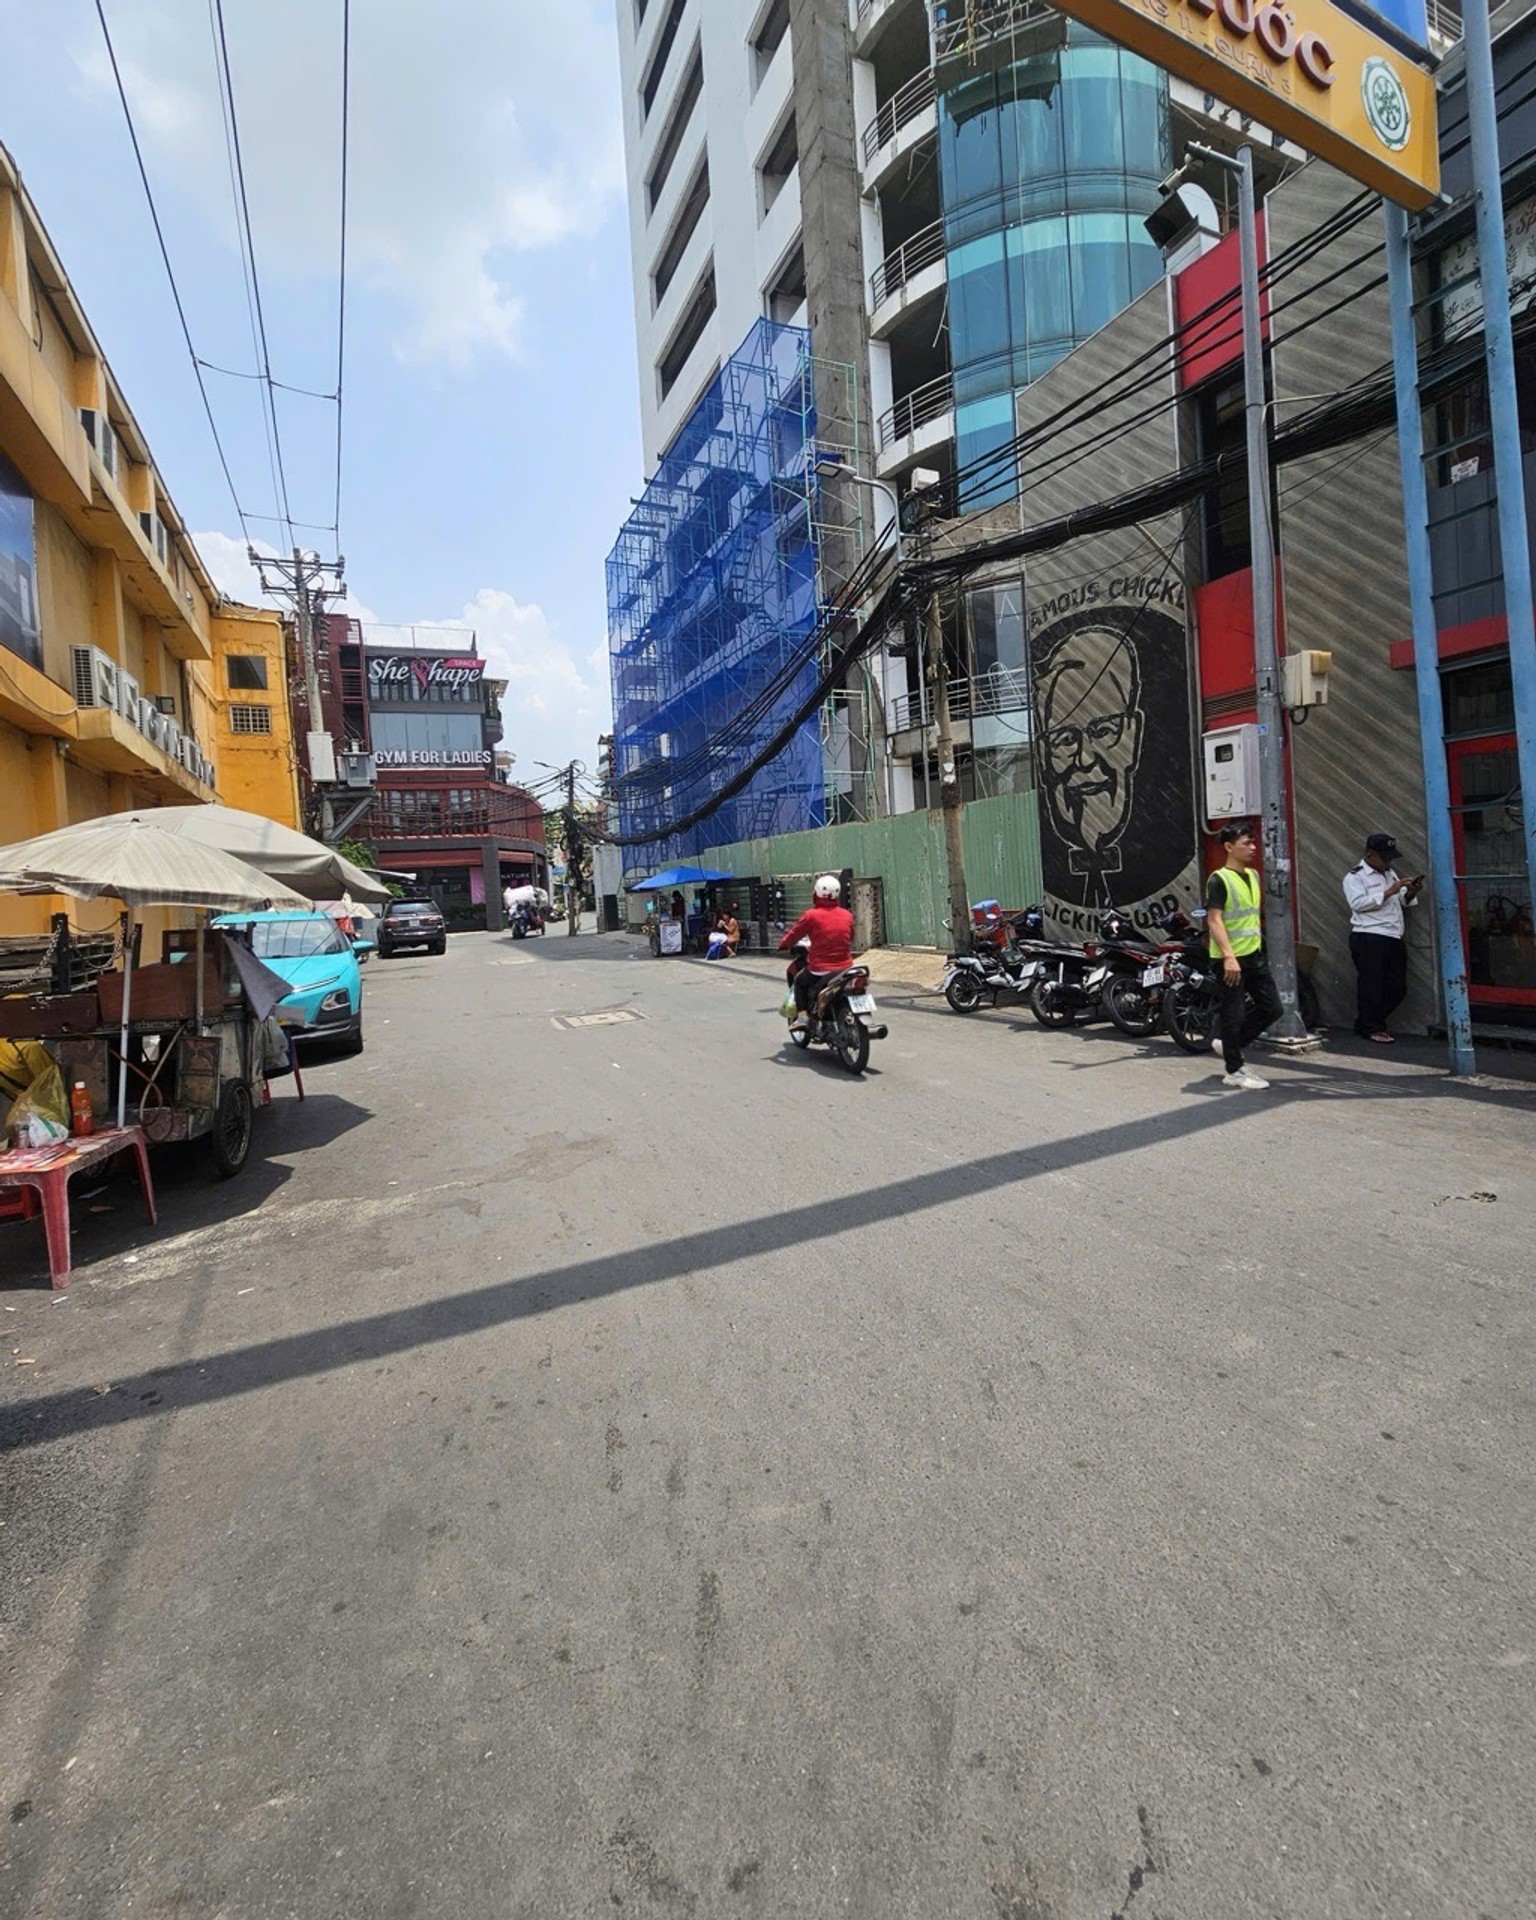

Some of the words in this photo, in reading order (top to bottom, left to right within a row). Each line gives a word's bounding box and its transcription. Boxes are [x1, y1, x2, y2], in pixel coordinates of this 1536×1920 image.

[368, 657, 410, 680] She
[374, 751, 407, 764] GYM
[412, 751, 440, 764] FOR
[443, 750, 492, 764] LADIES
